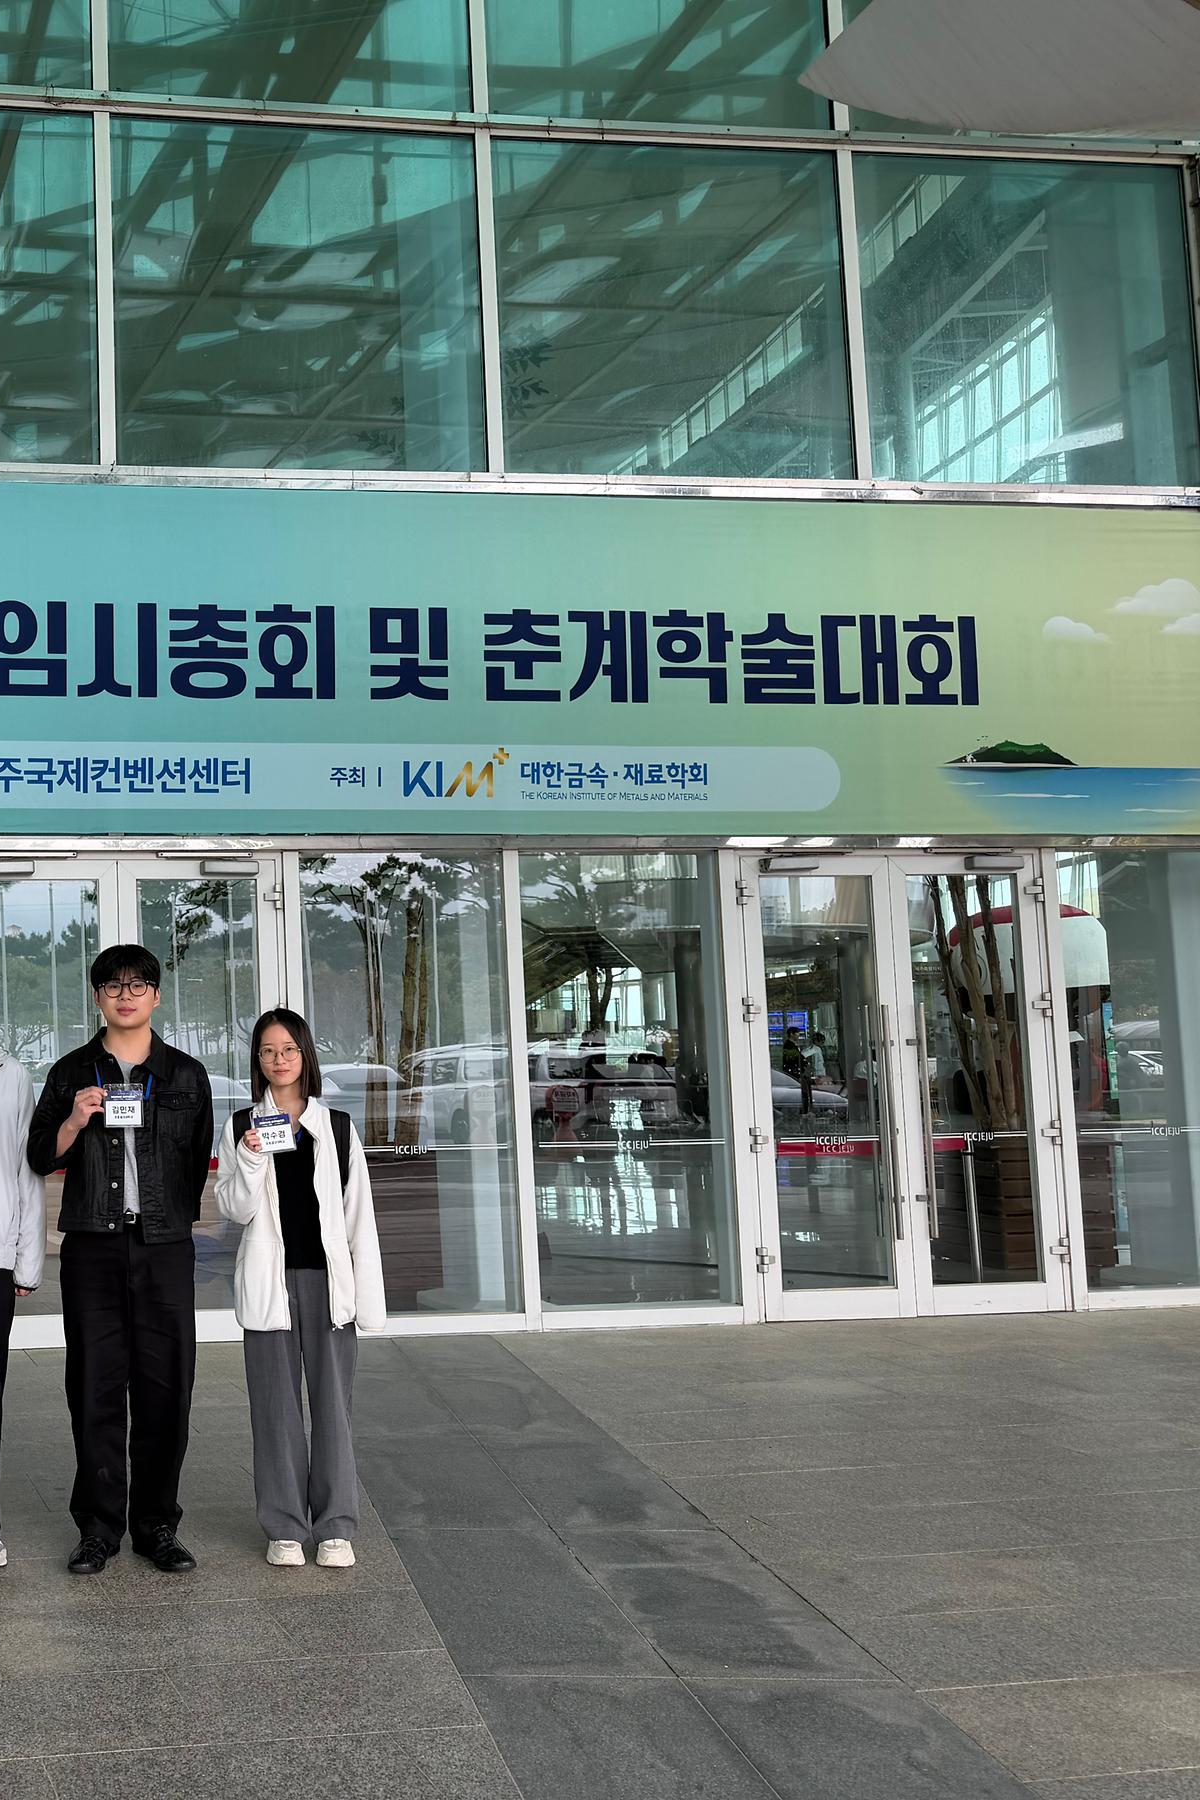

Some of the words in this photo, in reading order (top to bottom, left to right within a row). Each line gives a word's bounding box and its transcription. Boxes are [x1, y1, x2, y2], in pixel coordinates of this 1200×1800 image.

[369, 606, 449, 701] 및
[483, 608, 980, 706] 춘계학술대회
[330, 766, 366, 788] 주최
[402, 760, 494, 798] KIM
[536, 791, 568, 800] KOREAN
[570, 791, 606, 801] INSTITUTE
[619, 792, 649, 801] METALS
[667, 792, 708, 801] MATERIALS
